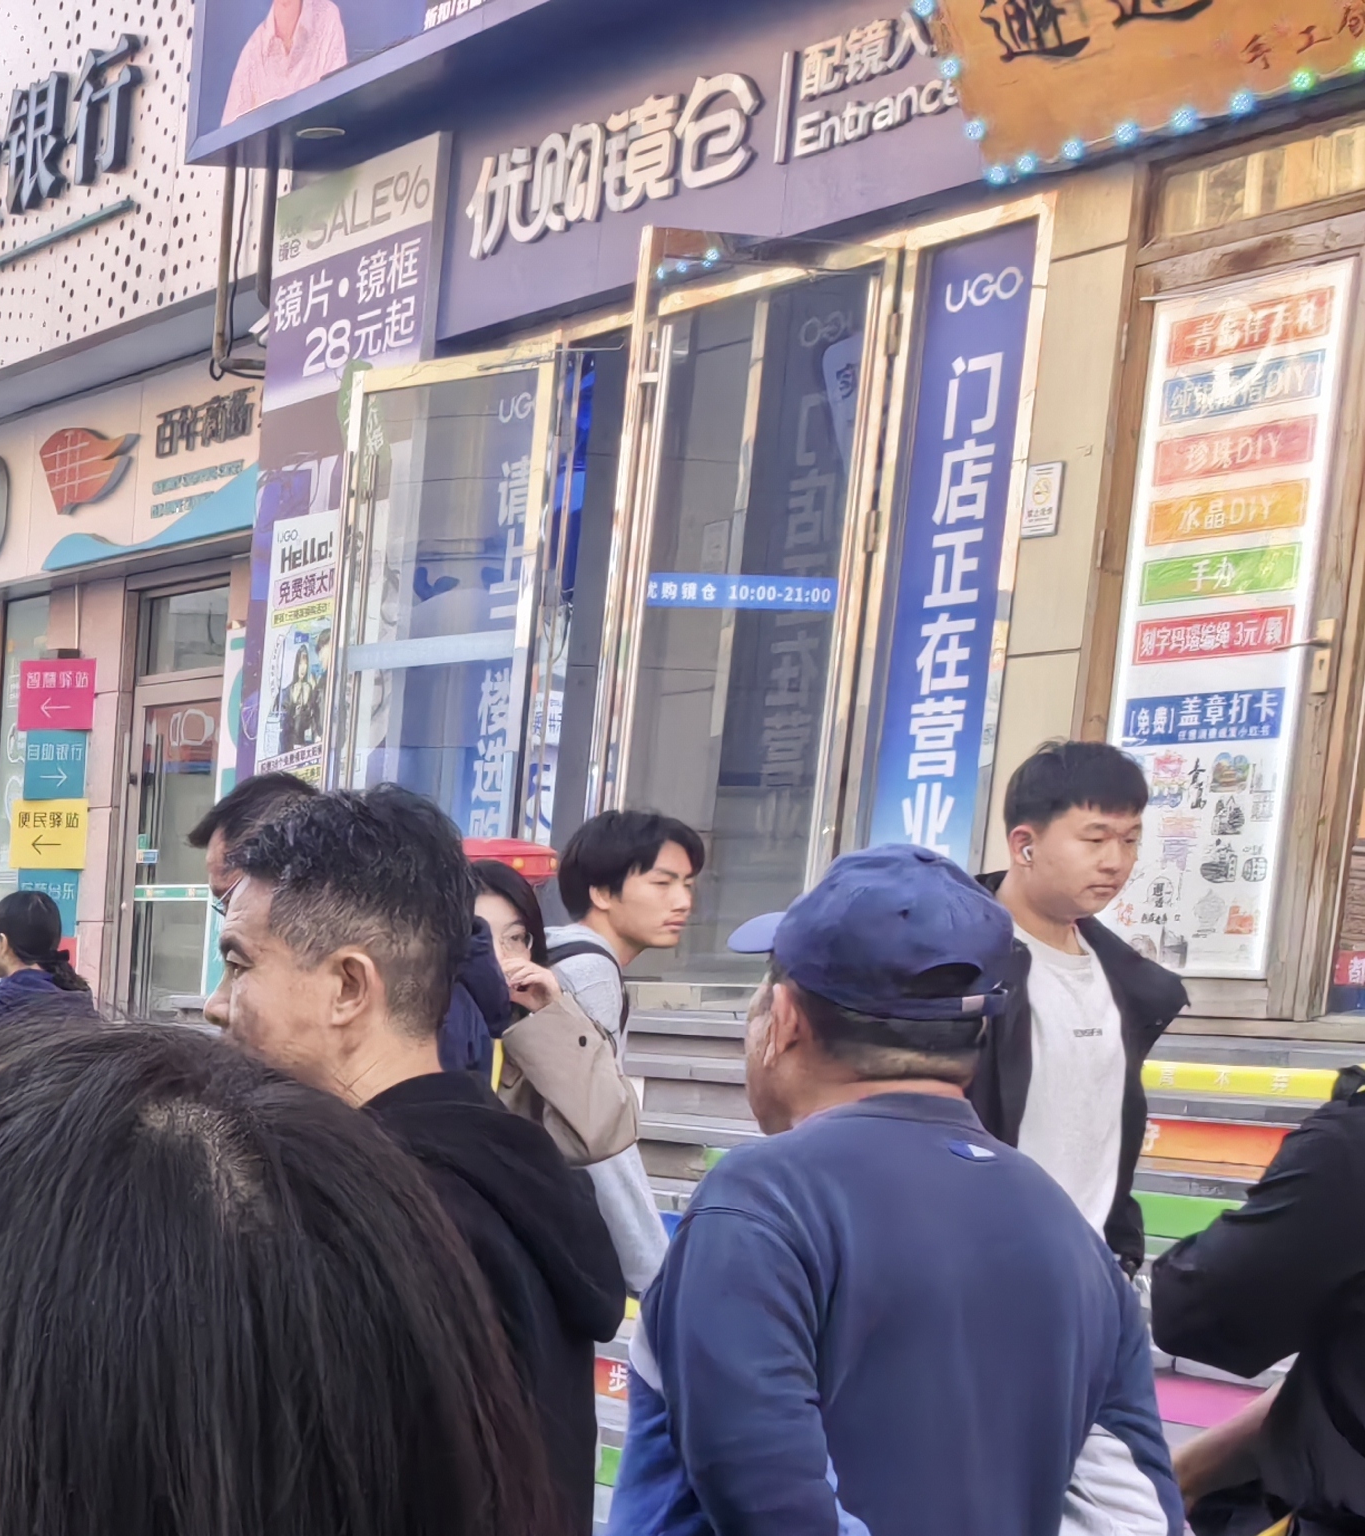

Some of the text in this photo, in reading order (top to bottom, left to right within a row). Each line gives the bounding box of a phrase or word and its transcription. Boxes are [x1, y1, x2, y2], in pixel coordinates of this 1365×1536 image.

[800, 10, 937, 102] 配镜入
[467, 73, 761, 260] 优购镜仓
[945, 266, 1023, 314] UGO
[302, 296, 415, 377] 28元起
[498, 391, 535, 425] UG
[280, 531, 333, 573] Hello!
[728, 585, 832, 604] 10:00-21:00
[902, 351, 1004, 853] 门店正在营业
[26, 671, 89, 689] 智慧驿站
[1178, 691, 1278, 727] 盖章打卡
[28, 744, 83, 761] 自助银行
[19, 812, 80, 829] 便民驿站
